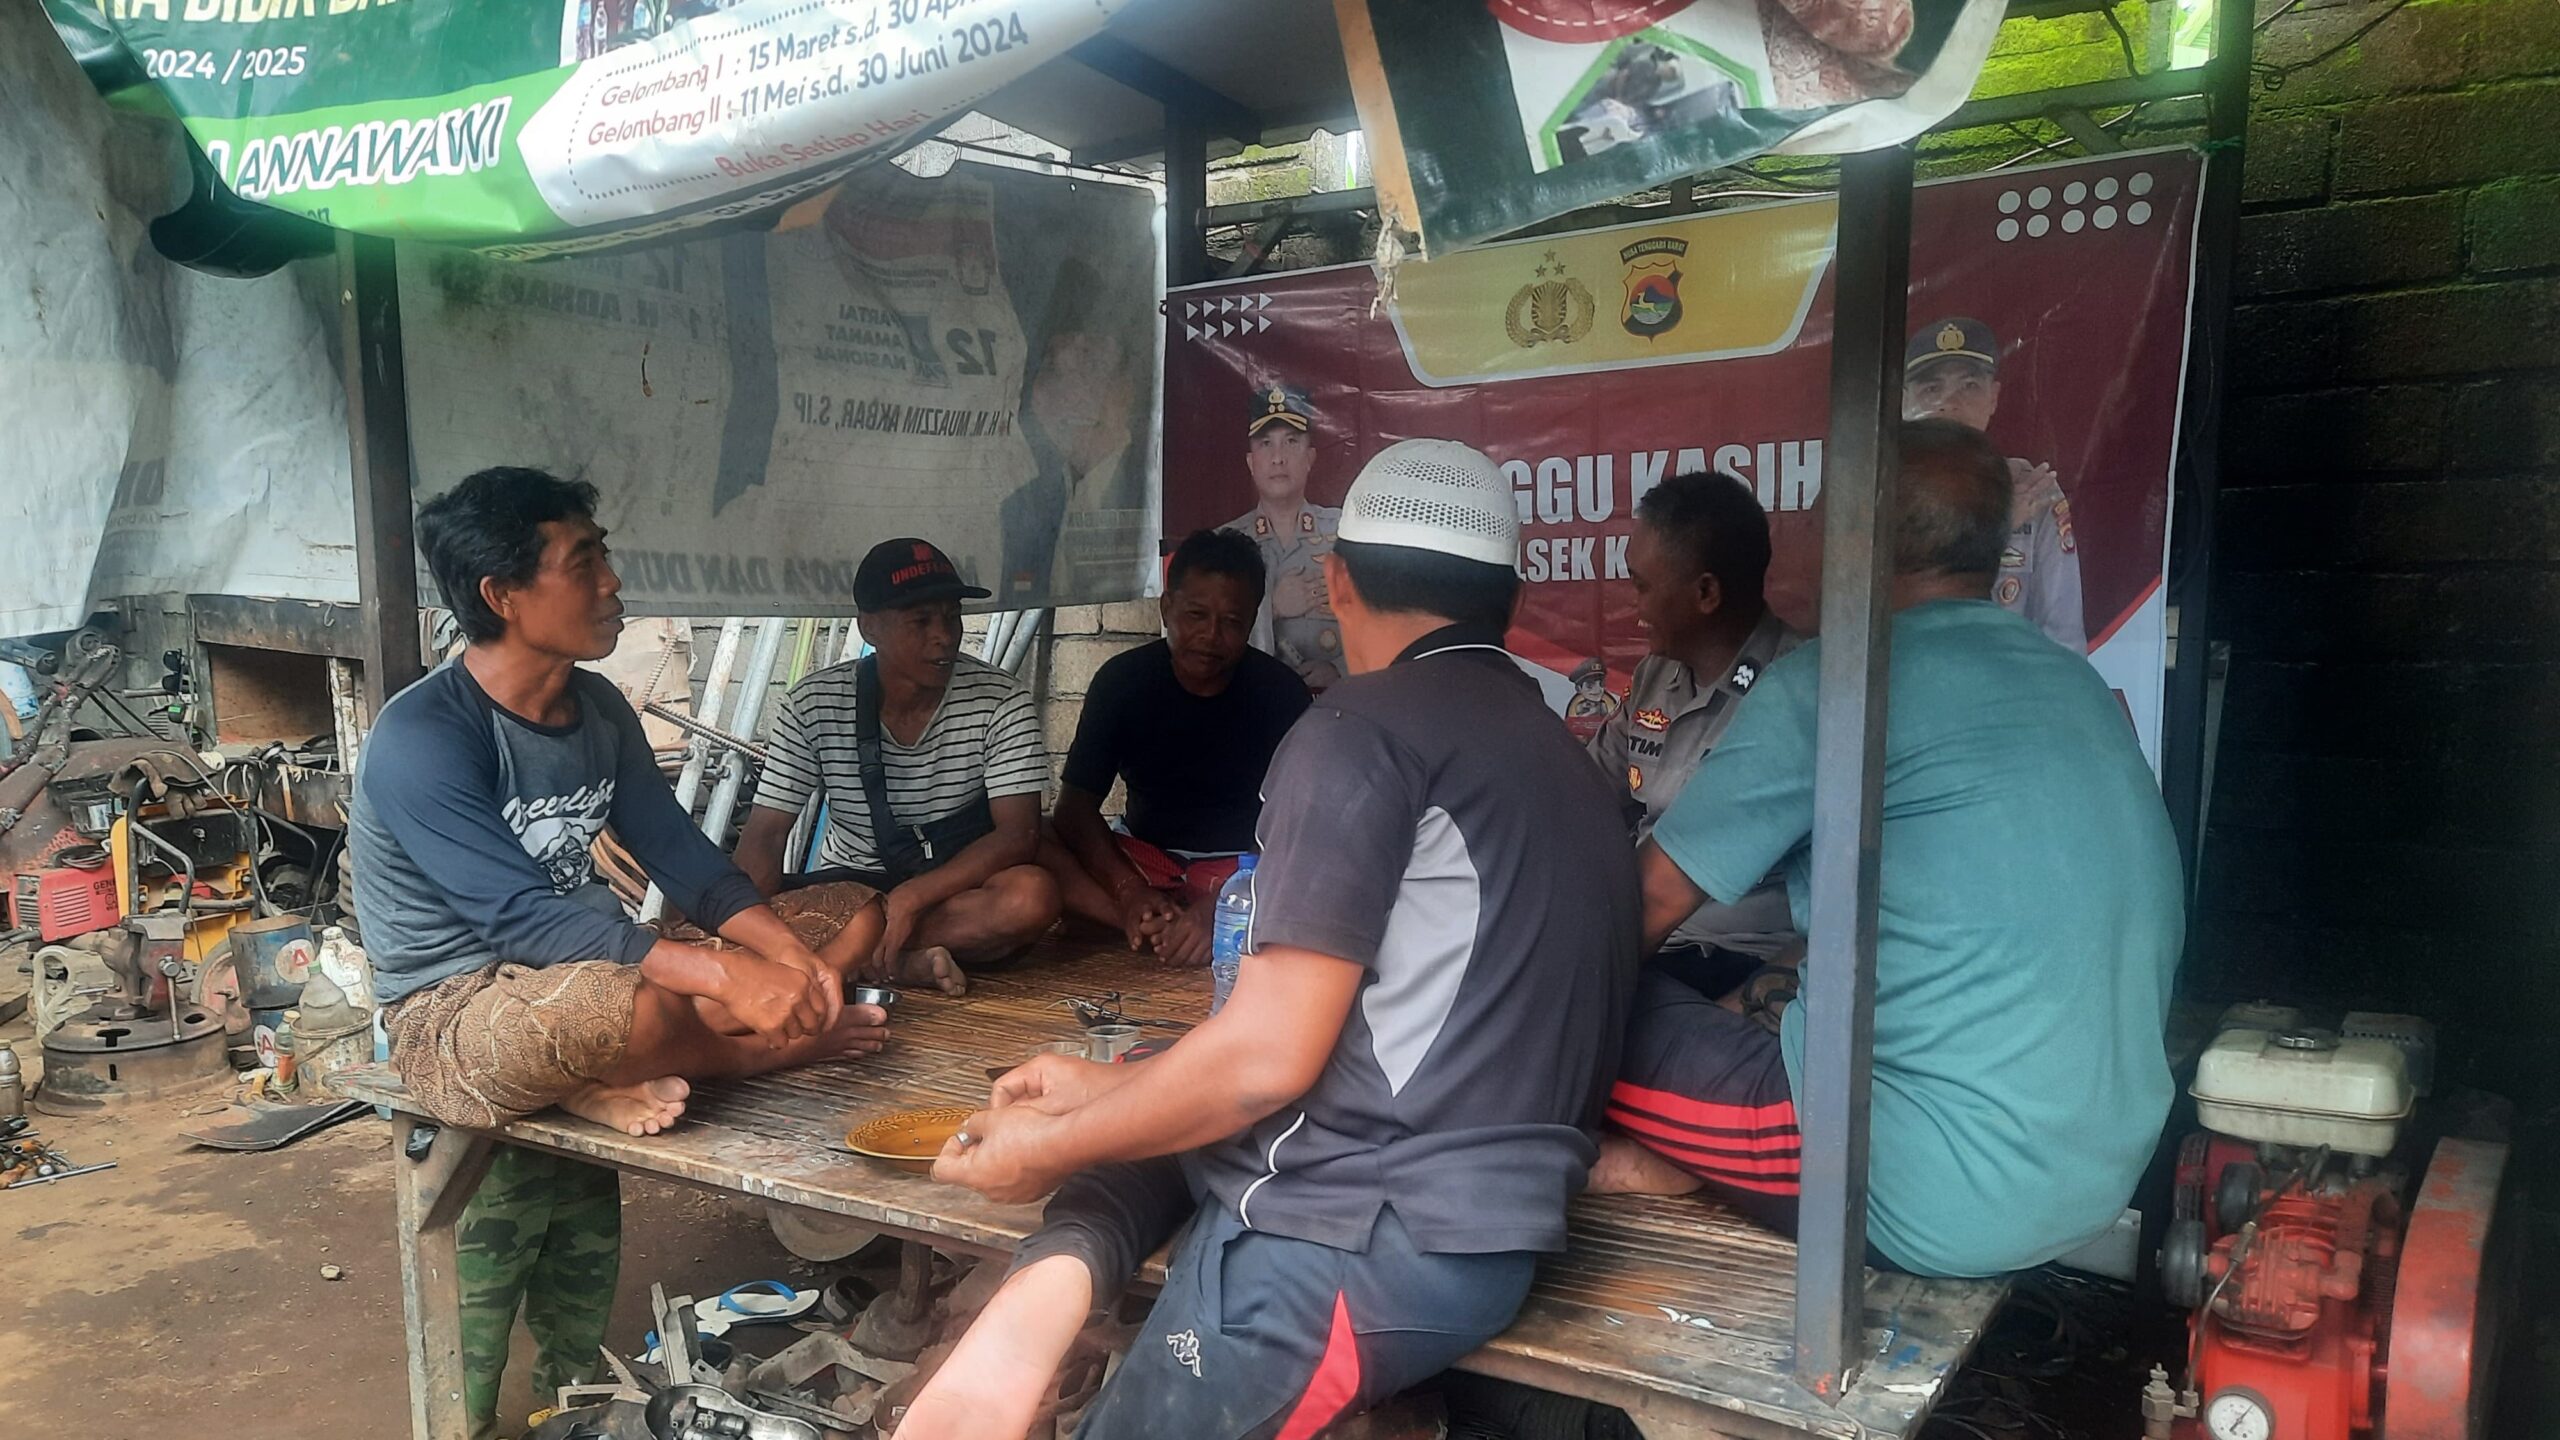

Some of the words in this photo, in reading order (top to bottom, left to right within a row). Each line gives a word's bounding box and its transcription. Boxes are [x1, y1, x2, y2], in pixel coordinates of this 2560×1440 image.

[143, 48, 216, 80] 2024
[242, 46, 307, 80] 2025
[588, 109, 705, 146] Gelombang
[741, 86, 758, 118] 11
[764, 75, 808, 112] Mei
[809, 65, 850, 101] s.d.
[857, 52, 888, 89] 30
[894, 35, 949, 80] Juni
[952, 12, 1029, 63] 2024
[601, 64, 709, 107] Gelombang
[749, 42, 770, 72] 15
[776, 28, 840, 68] Maret
[844, 7, 881, 46] s.d.
[715, 150, 788, 178] Buka
[779, 132, 871, 162] Setiap
[865, 109, 933, 137] Hari
[1500, 453, 1614, 525] GGU
[1605, 535, 1631, 580] K
[1627, 734, 1665, 758] TIM
